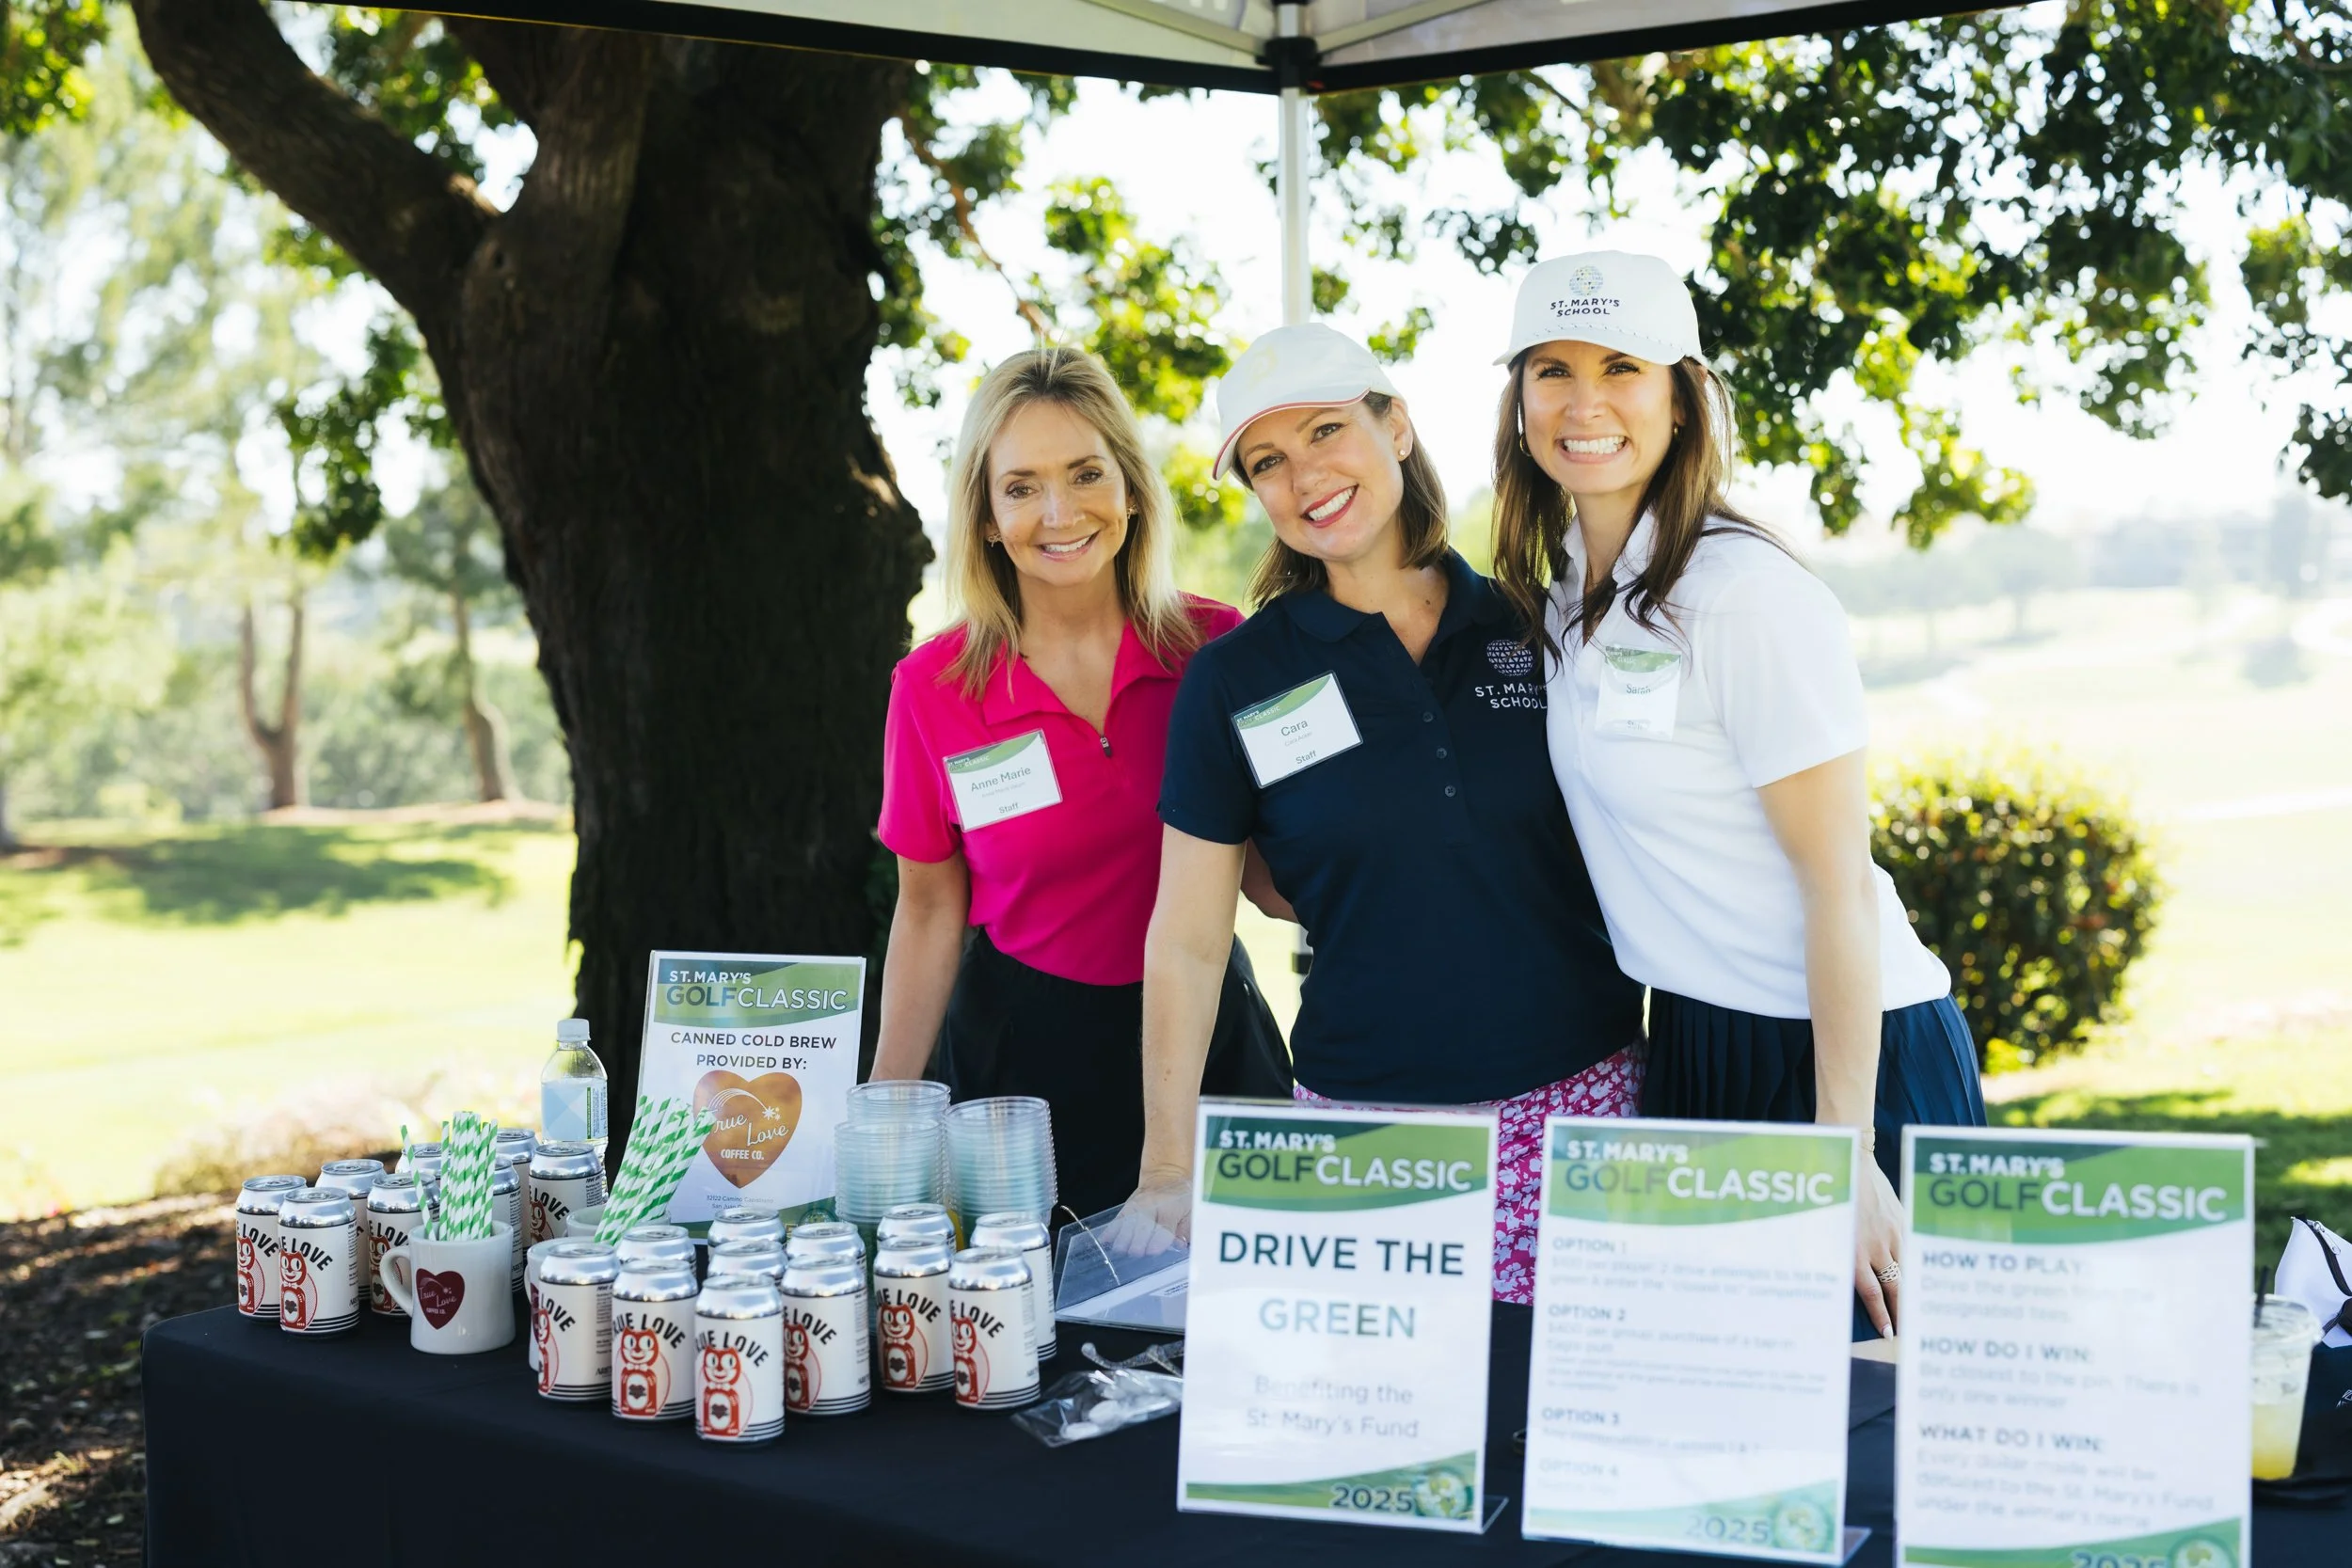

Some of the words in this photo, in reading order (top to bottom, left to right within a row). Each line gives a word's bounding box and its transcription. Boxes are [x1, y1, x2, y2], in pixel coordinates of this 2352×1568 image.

[1550, 300, 1567, 310] ST.
[1571, 297, 1620, 307] MARY'S
[1557, 308, 1610, 317] SCHOOL
[1475, 685, 1501, 697] ST.
[1490, 697, 1547, 709] SCHOOL
[1280, 720, 1309, 736] Cara
[1295, 750, 1317, 765] Staff
[971, 777, 999, 792] Anne
[1000, 767, 1031, 783] Marie
[998, 802, 1019, 814] Staff
[670, 971, 691, 983] ST.
[694, 972, 752, 985] MARY'S
[671, 1032, 737, 1046] CANNED
[741, 1034, 785, 1047] COLD
[789, 1036, 837, 1049] BREW
[696, 1054, 777, 1069] PROVIDED
[782, 1056, 807, 1069] BY:
[712, 1112, 748, 1134] rue
[747, 1125, 789, 1147] Love
[1219, 1130, 1251, 1148] ST.
[1254, 1132, 1336, 1152] MARY'S
[721, 1148, 750, 1160] COFFEE
[751, 1149, 765, 1161] CO.
[1567, 1140, 1600, 1160] ST.
[1603, 1141, 1689, 1163] MARY'S
[1930, 1153, 1968, 1175] ST.
[1970, 1155, 2065, 1179] MARY'S
[534, 1187, 570, 1221] LOVE
[243, 1223, 279, 1258] LOVE
[376, 1223, 409, 1247] LOV
[1553, 1236, 1615, 1254] OPTION
[292, 1238, 333, 1271] LOVE
[1219, 1231, 1358, 1270] DRIVE
[1376, 1240, 1465, 1275] THE
[1923, 1251, 1979, 1270] HOW
[1989, 1253, 2019, 1272] TO
[541, 1293, 576, 1332] LOVE
[897, 1290, 942, 1323] LOVE
[1548, 1304, 1611, 1322] OPTION
[793, 1308, 837, 1345] LOVE
[961, 1302, 1005, 1338] LOVE
[1259, 1298, 1416, 1338] GREEN
[641, 1314, 686, 1349] LOVE
[723, 1331, 770, 1367] LOVE
[1920, 1338, 1978, 1355] HOW
[1984, 1339, 2019, 1359] DO
[2026, 1343, 2033, 1360] I
[1255, 1374, 1368, 1405] Benefiting
[1376, 1383, 1413, 1404] the
[1282, 1410, 1353, 1436] Mary's
[1360, 1415, 1419, 1438] Fund
[1542, 1407, 1606, 1425] OPTION
[1920, 1423, 1987, 1443] WHAT
[1994, 1426, 2030, 1448] DO
[2037, 1430, 2044, 1449] I
[1539, 1458, 1604, 1478] OPTION
[1330, 1484, 1412, 1513] 2025
[1686, 1514, 1771, 1544] 2025
